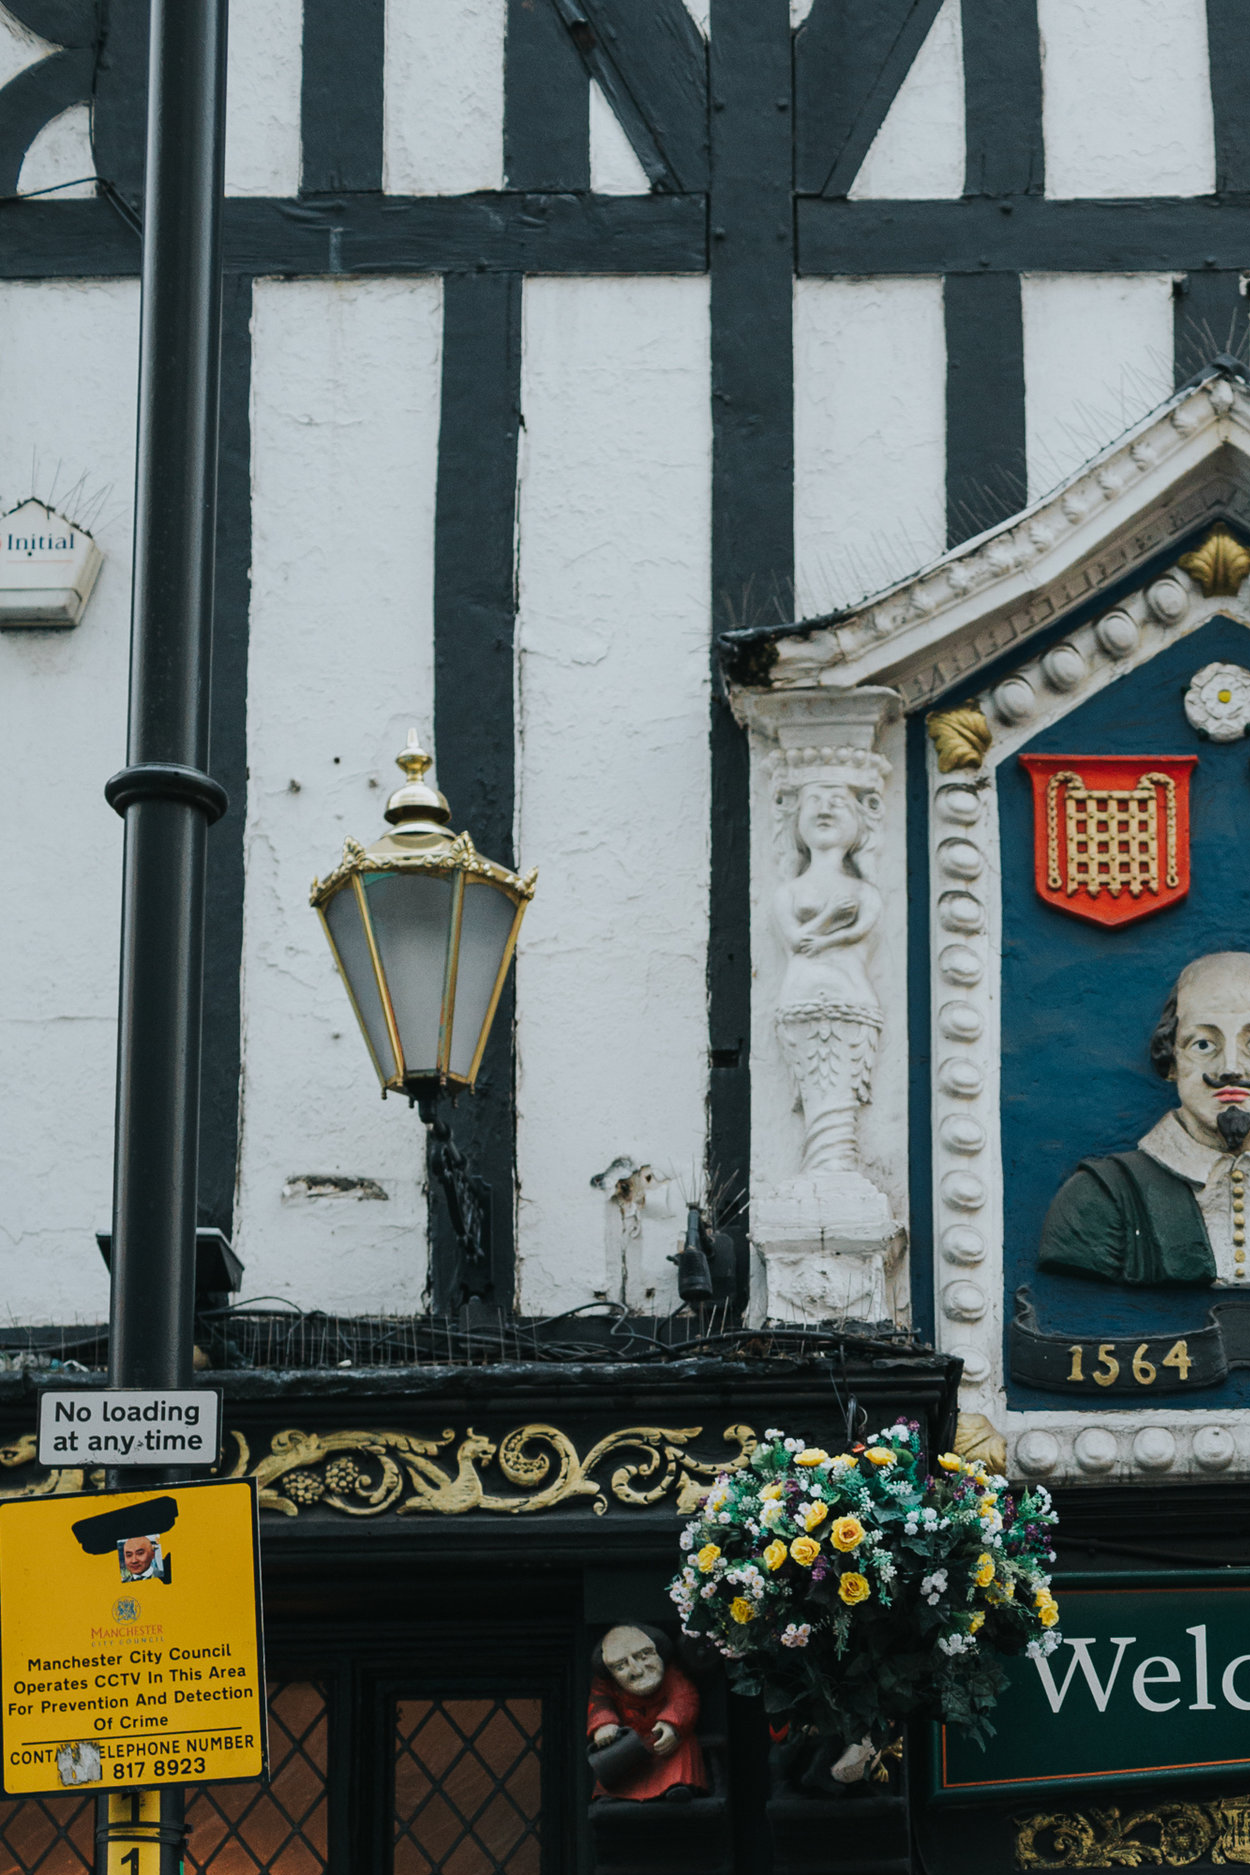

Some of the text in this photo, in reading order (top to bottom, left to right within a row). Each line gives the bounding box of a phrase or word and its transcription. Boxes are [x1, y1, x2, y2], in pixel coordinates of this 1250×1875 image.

[8, 533, 74, 550] Initial
[1066, 1339, 1191, 1386] 1564
[55, 1400, 200, 1426] No loading
[53, 1429, 203, 1455] at any time
[28, 1644, 231, 1671] Manchester City Council
[14, 1666, 246, 1695] Operates CCTV In This Area
[8, 1686, 253, 1716] For Prevention And Detection
[94, 1715, 168, 1731] Of Crime
[10, 1735, 254, 1766] CONT ELEPHONE NUMBER
[113, 1762, 145, 1780] 817
[154, 1757, 206, 1776] 8923
